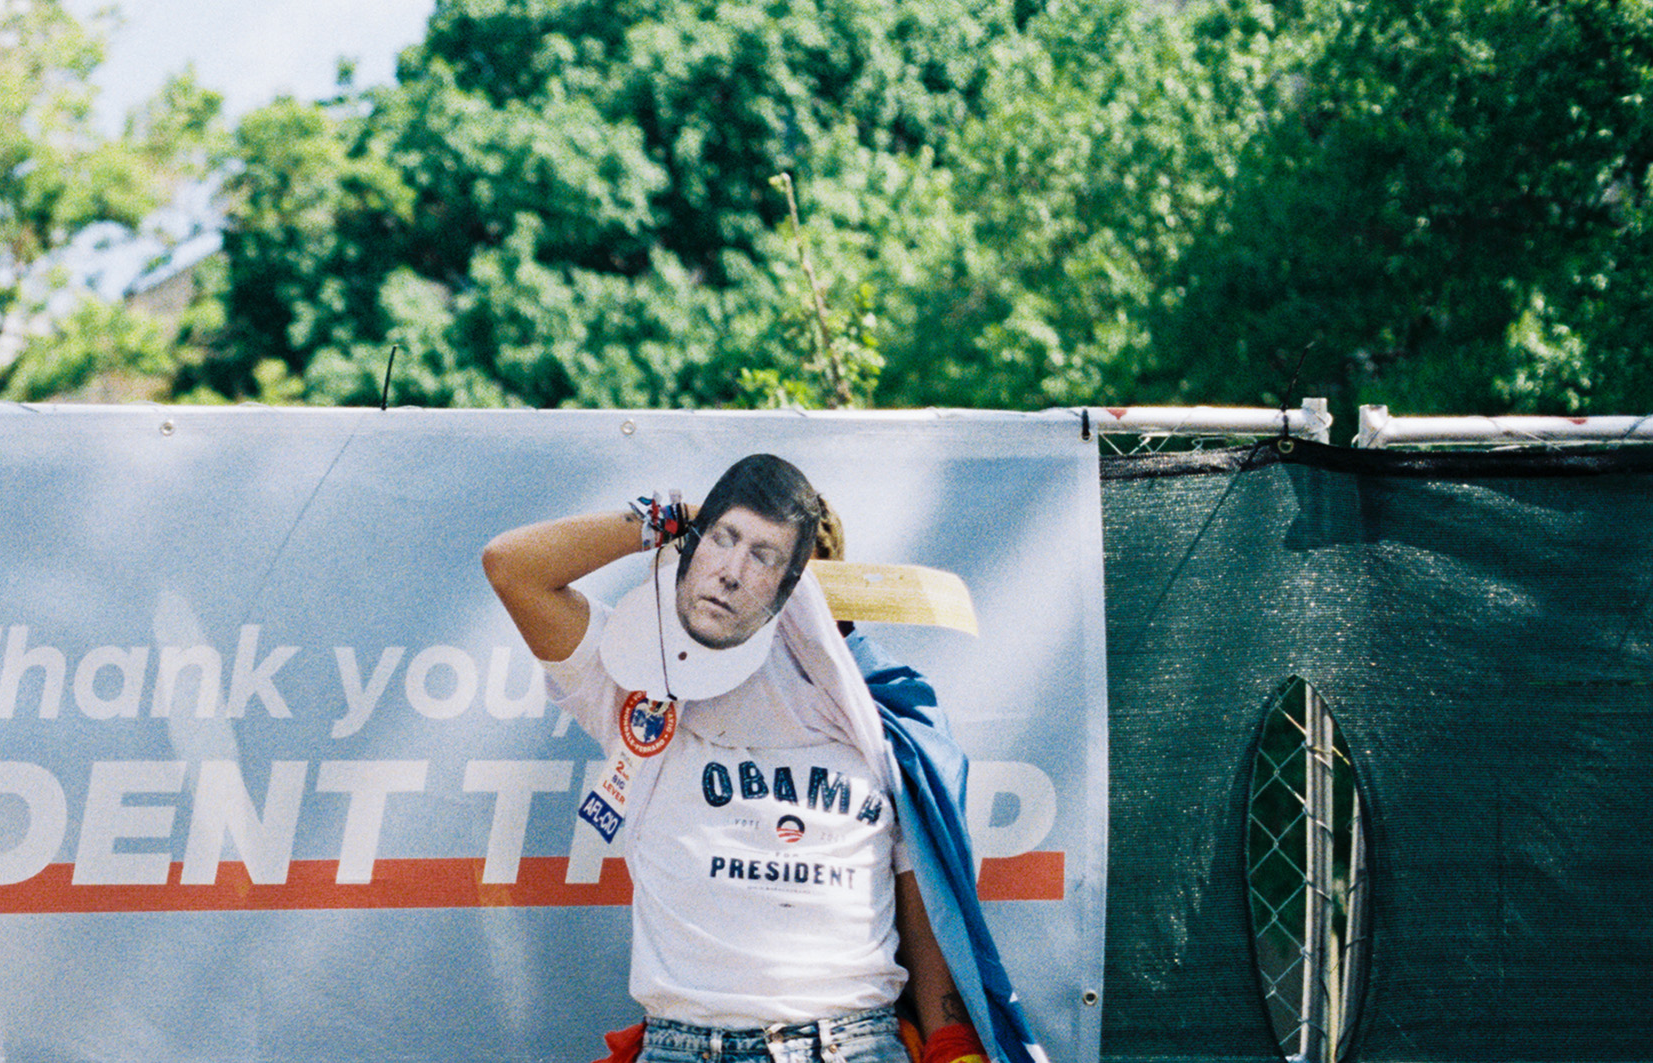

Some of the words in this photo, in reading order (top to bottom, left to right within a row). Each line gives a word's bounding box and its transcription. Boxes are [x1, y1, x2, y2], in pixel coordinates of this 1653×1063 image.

[602, 780, 626, 806] LEVER
[702, 760, 887, 826] OBAMA
[583, 797, 619, 836] AFL-CIO
[710, 856, 857, 887] PRESIDENT
